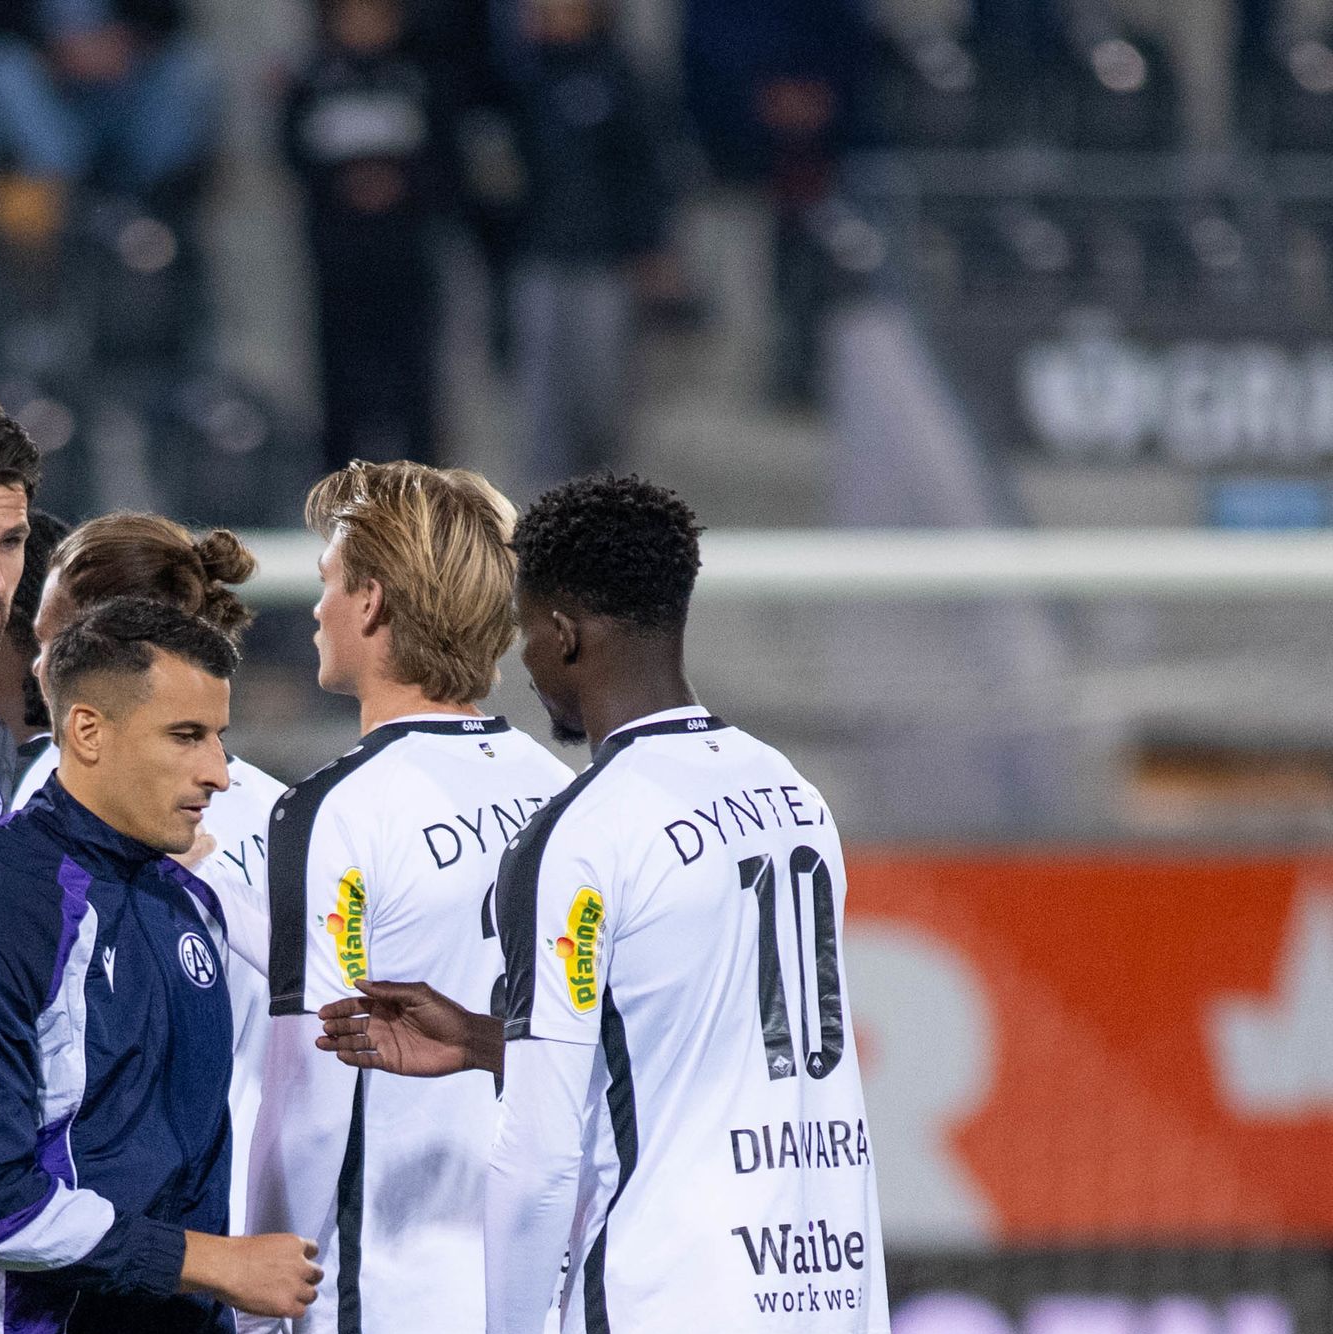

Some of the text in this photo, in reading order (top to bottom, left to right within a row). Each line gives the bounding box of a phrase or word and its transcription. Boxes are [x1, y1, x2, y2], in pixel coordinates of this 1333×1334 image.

[462, 720, 484, 732] 6844
[687, 718, 709, 731] 6844
[569, 896, 604, 1005] pfanner
[737, 845, 845, 1081] 10
